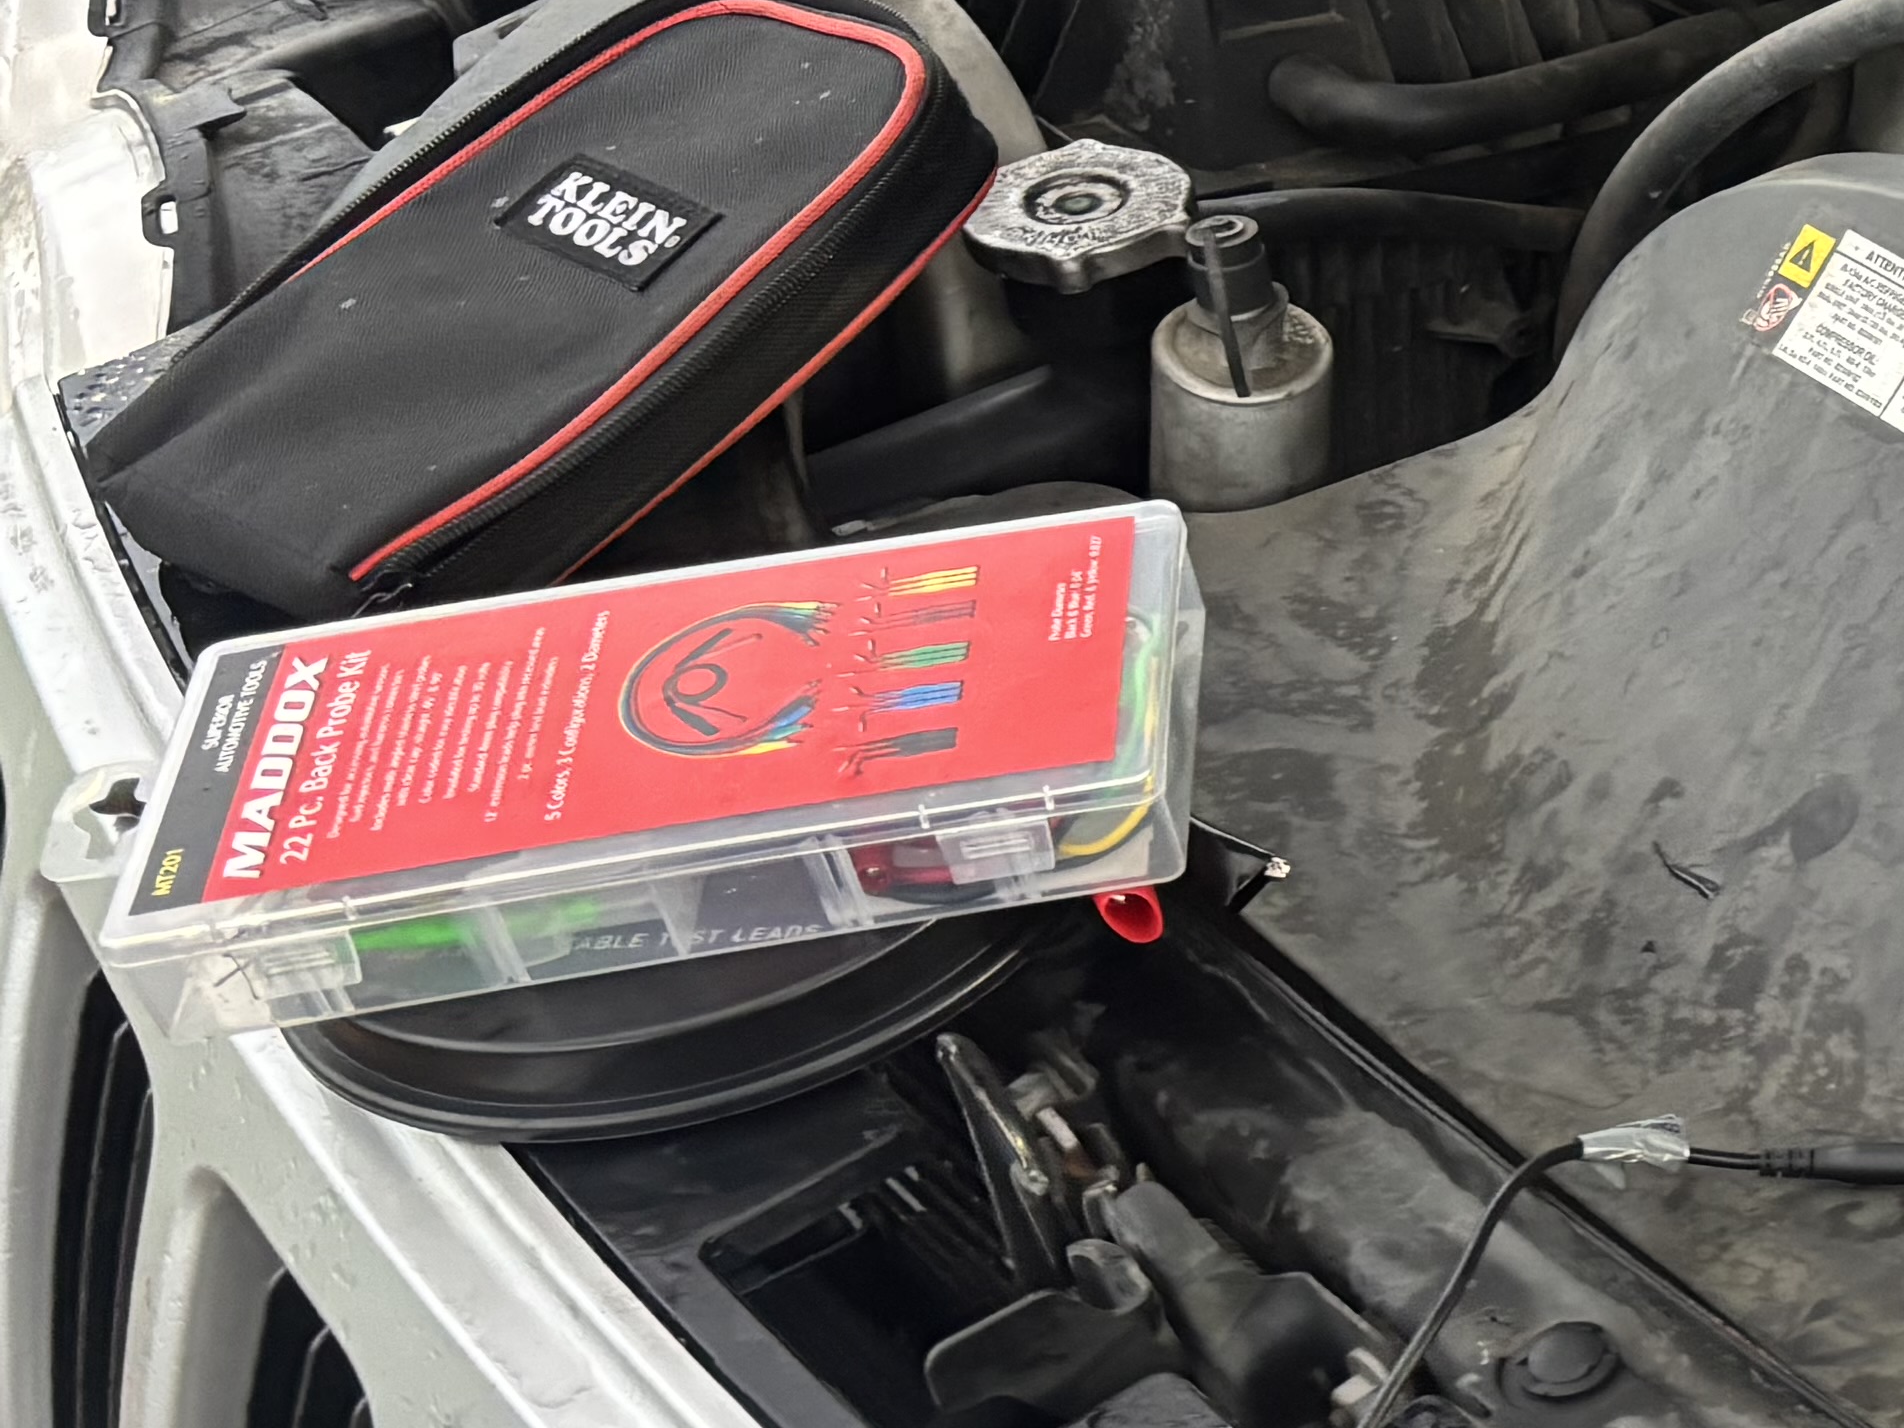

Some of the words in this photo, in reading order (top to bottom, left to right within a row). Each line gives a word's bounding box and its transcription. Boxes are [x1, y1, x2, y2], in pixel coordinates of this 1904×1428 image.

[528, 194, 658, 265] TOOLS
[548, 172, 685, 243] KLEIN
[336, 649, 371, 677] Kit
[201, 694, 234, 750] SUPERIOR
[215, 698, 253, 772] AUTOMOTIVE
[239, 659, 267, 697] TOOLS
[316, 681, 359, 738] Probe
[543, 810, 561, 820] 5
[581, 610, 609, 662] Diameters
[224, 658, 325, 877] MADDOX
[299, 741, 339, 792] Back
[288, 795, 323, 828] Pc.
[151, 848, 182, 895] MT201
[279, 833, 313, 864] 22
[658, 927, 725, 949] TST
[729, 922, 827, 943] LEADS
